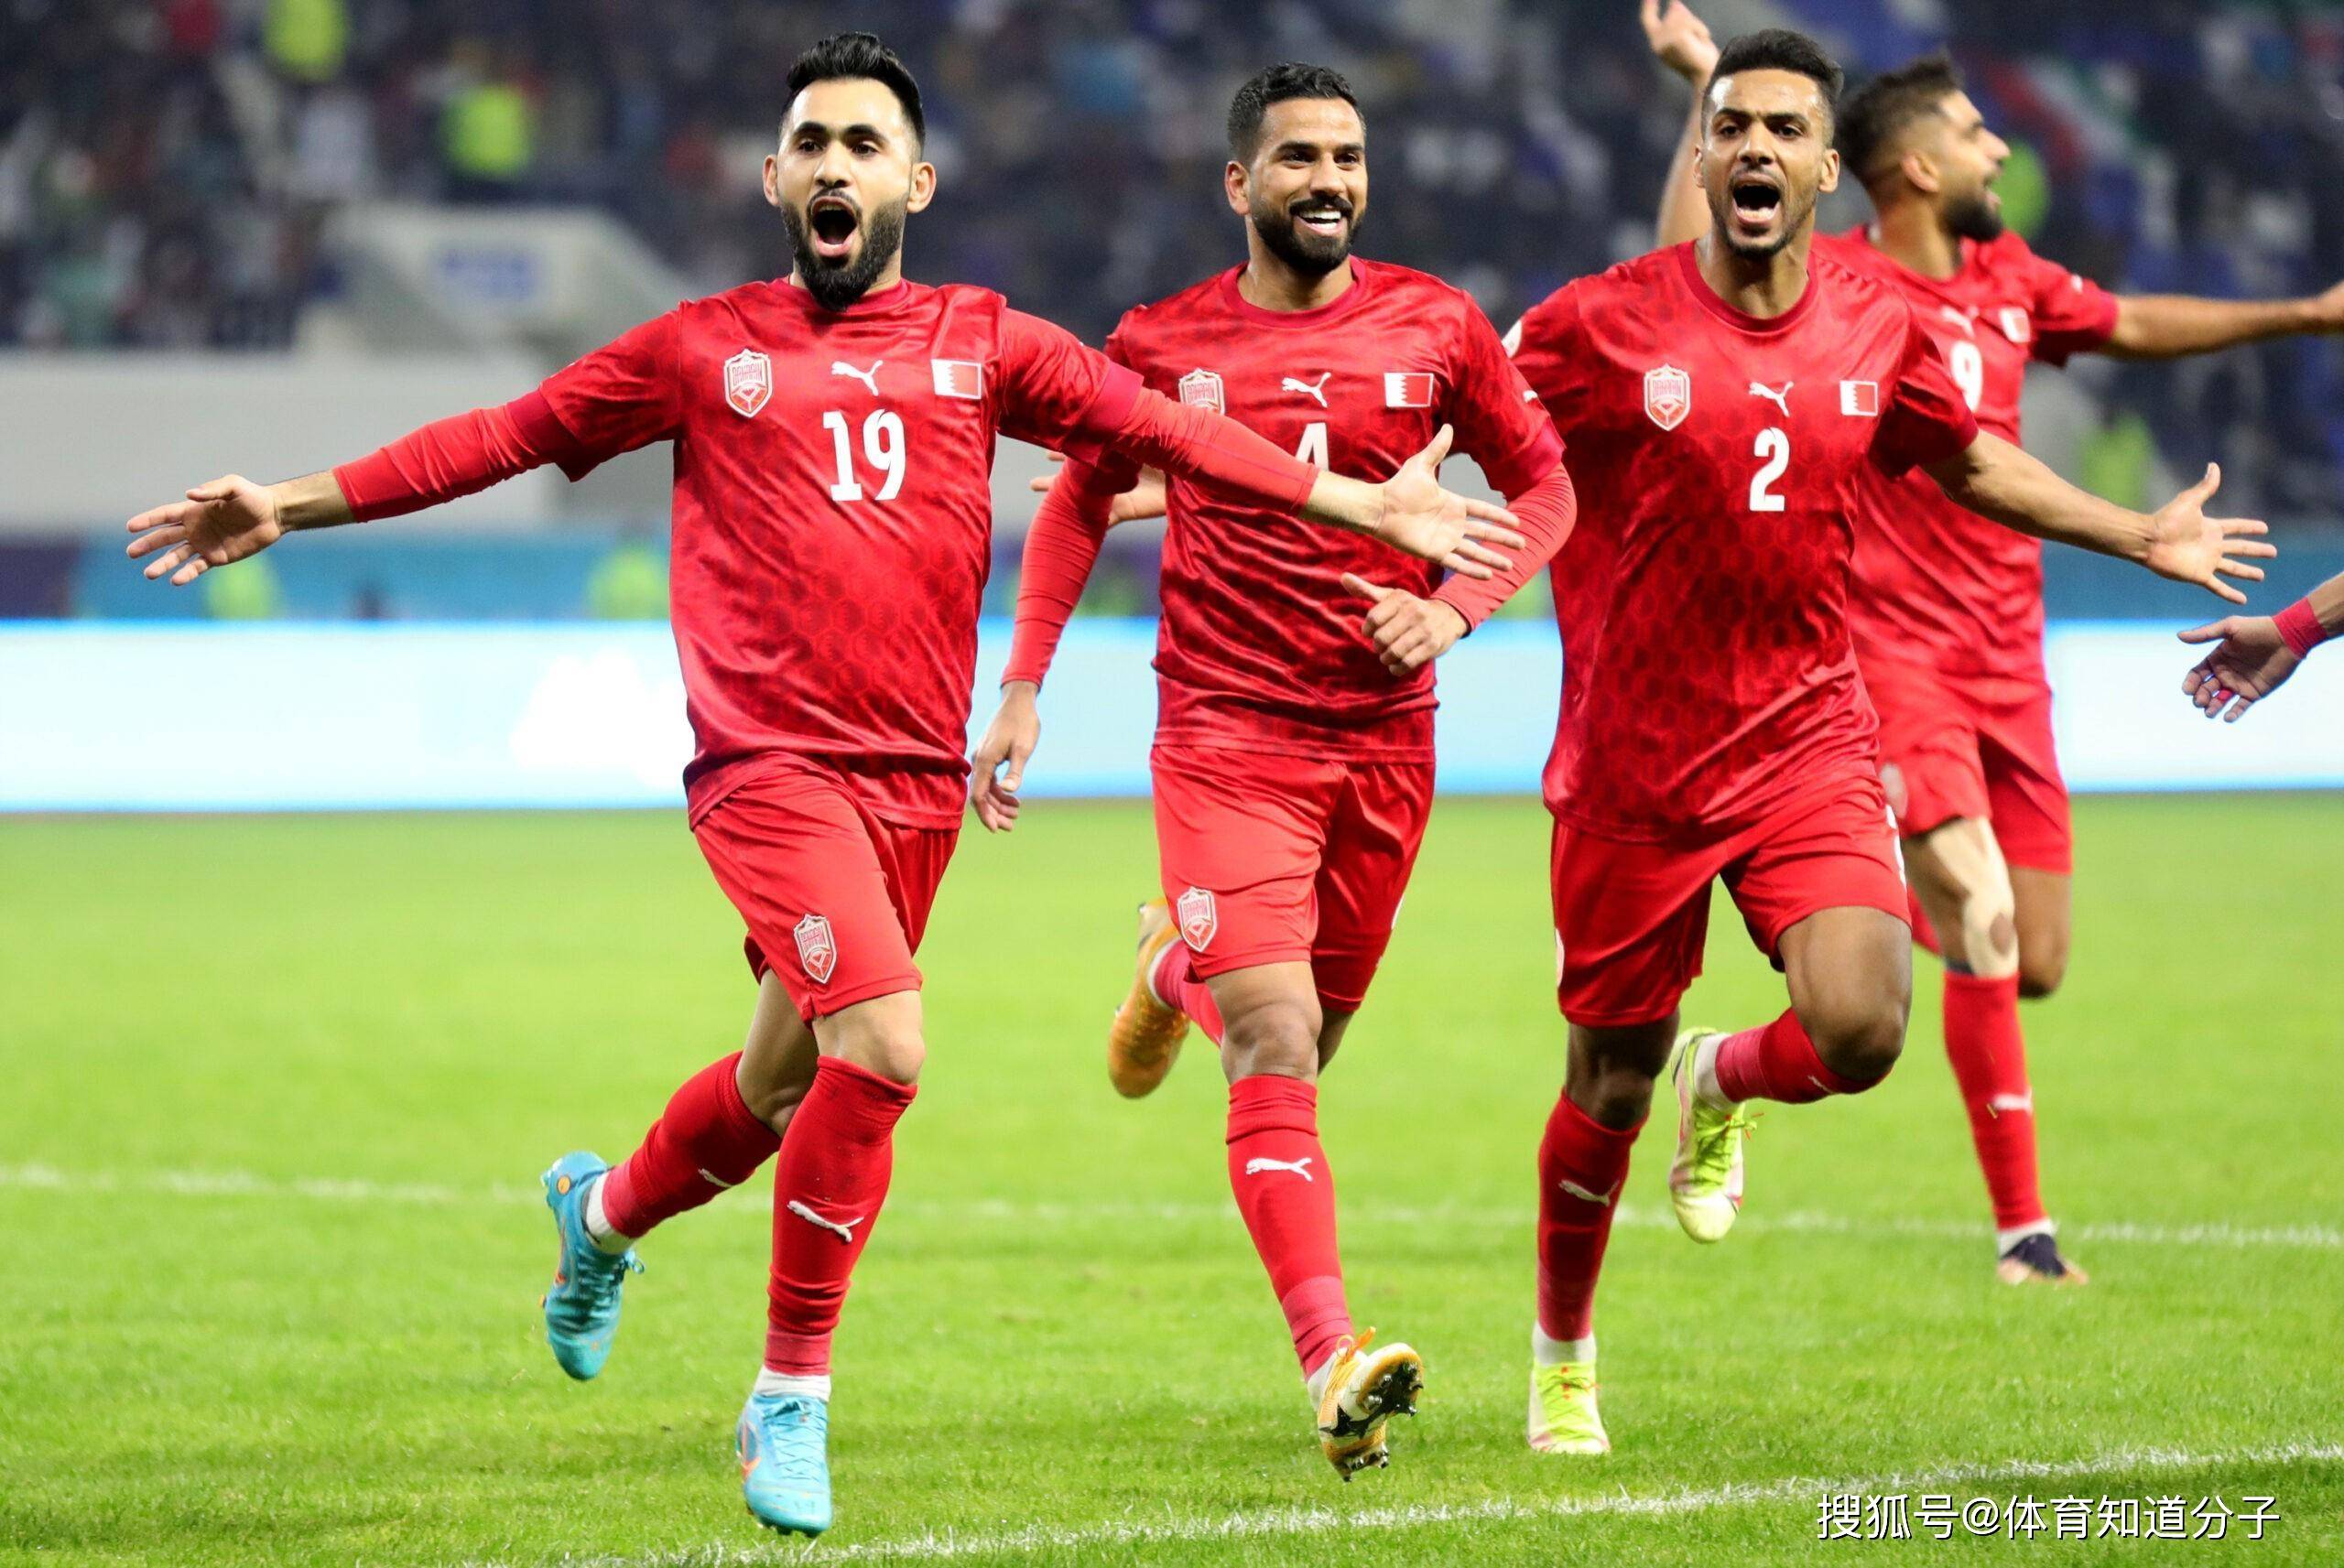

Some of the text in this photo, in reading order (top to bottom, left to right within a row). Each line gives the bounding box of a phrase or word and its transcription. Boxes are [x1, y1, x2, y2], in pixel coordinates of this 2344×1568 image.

[1950, 341, 1983, 412] 9
[823, 409, 906, 502] 19
[1750, 427, 1790, 512] 2
